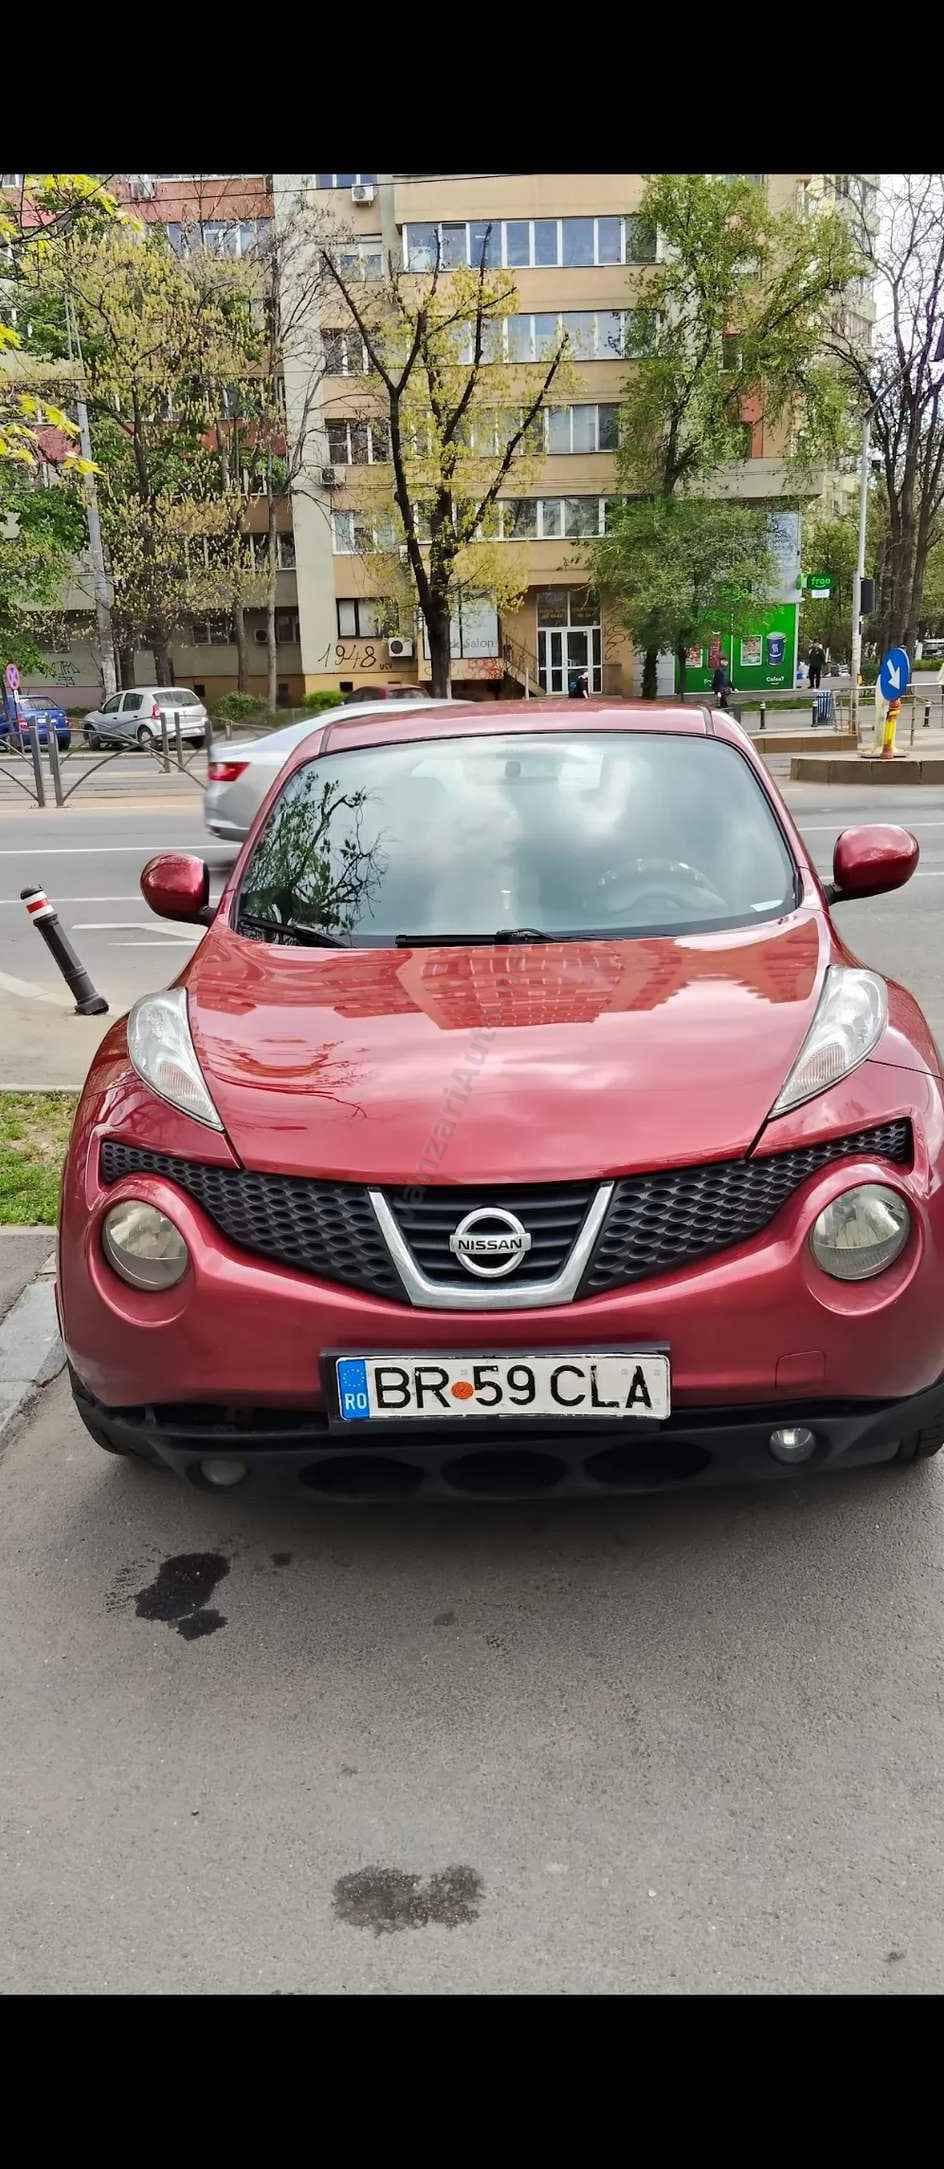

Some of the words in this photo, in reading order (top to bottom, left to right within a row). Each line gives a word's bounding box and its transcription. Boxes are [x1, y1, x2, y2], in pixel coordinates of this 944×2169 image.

[458, 1238, 523, 1251] NISSAN
[374, 1366, 450, 1409] BR
[473, 1364, 536, 1406] 59
[550, 1364, 654, 1410] CLA
[345, 1393, 367, 1410] RO
